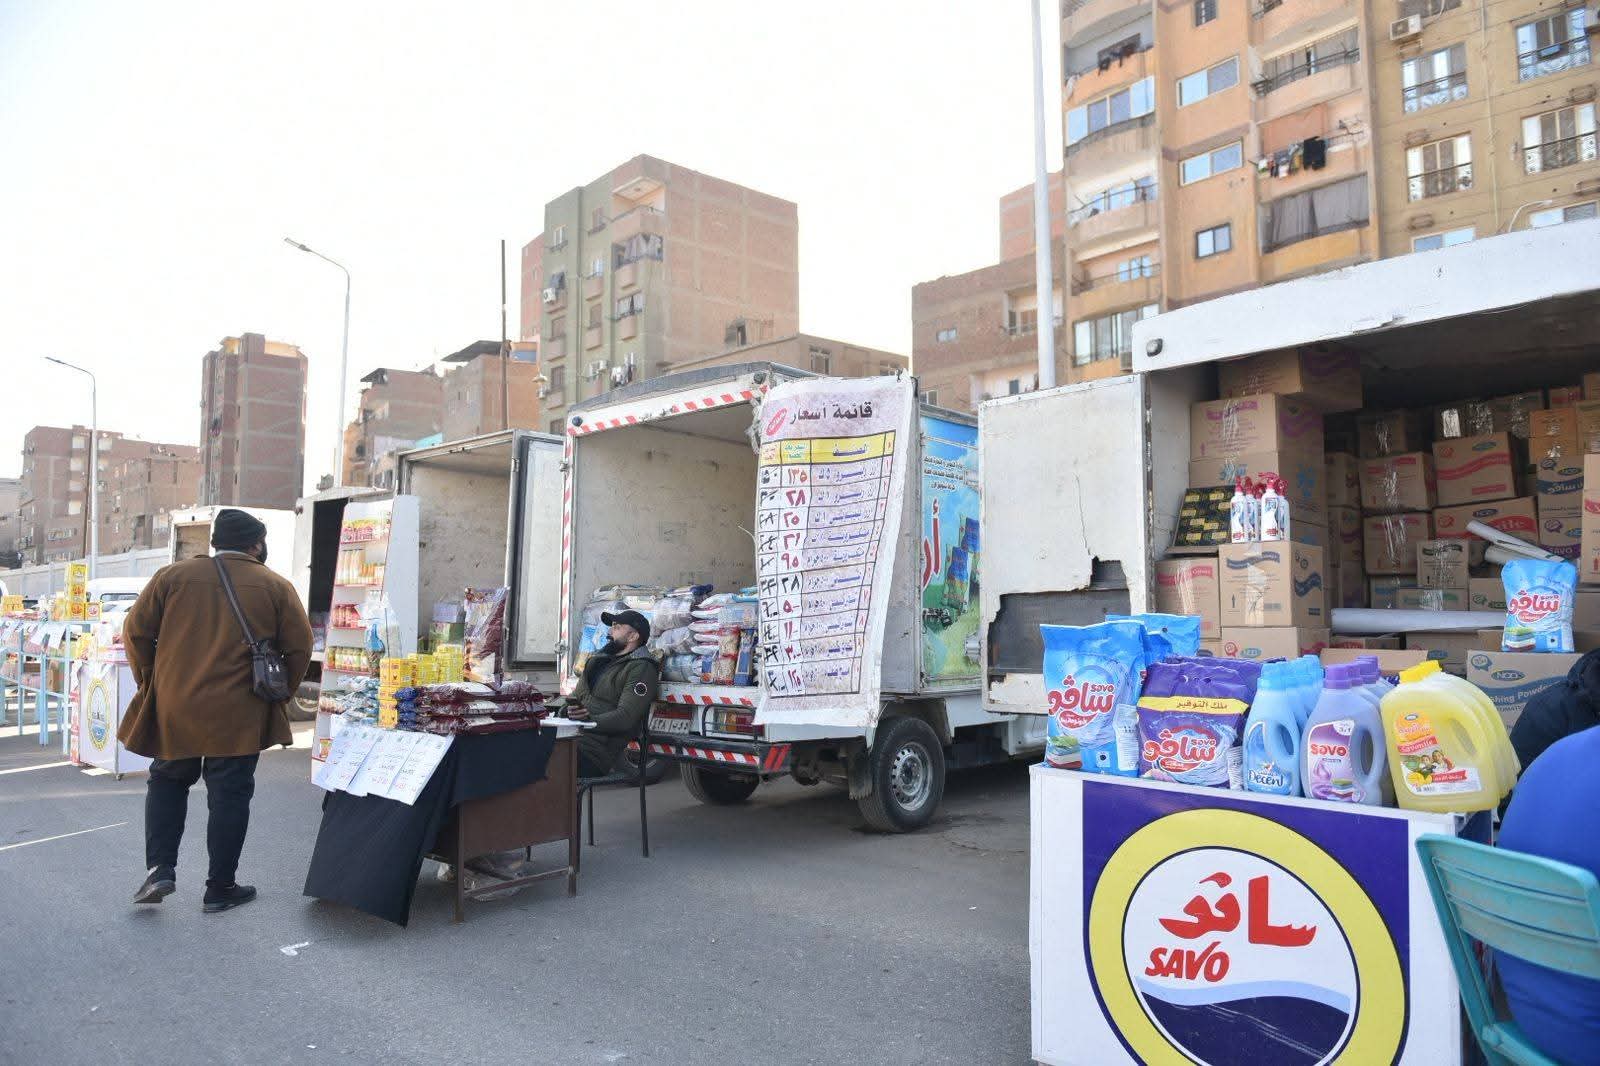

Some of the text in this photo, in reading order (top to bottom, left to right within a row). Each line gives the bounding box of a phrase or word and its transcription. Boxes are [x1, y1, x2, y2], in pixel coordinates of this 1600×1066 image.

[790, 402, 826, 425] أسعار
[833, 401, 873, 420] قائمة
[786, 489, 806, 507] ٢٨
[783, 511, 800, 528] ٢٥
[1211, 701, 1228, 710] ملك
[1145, 941, 1230, 983] SAVO
